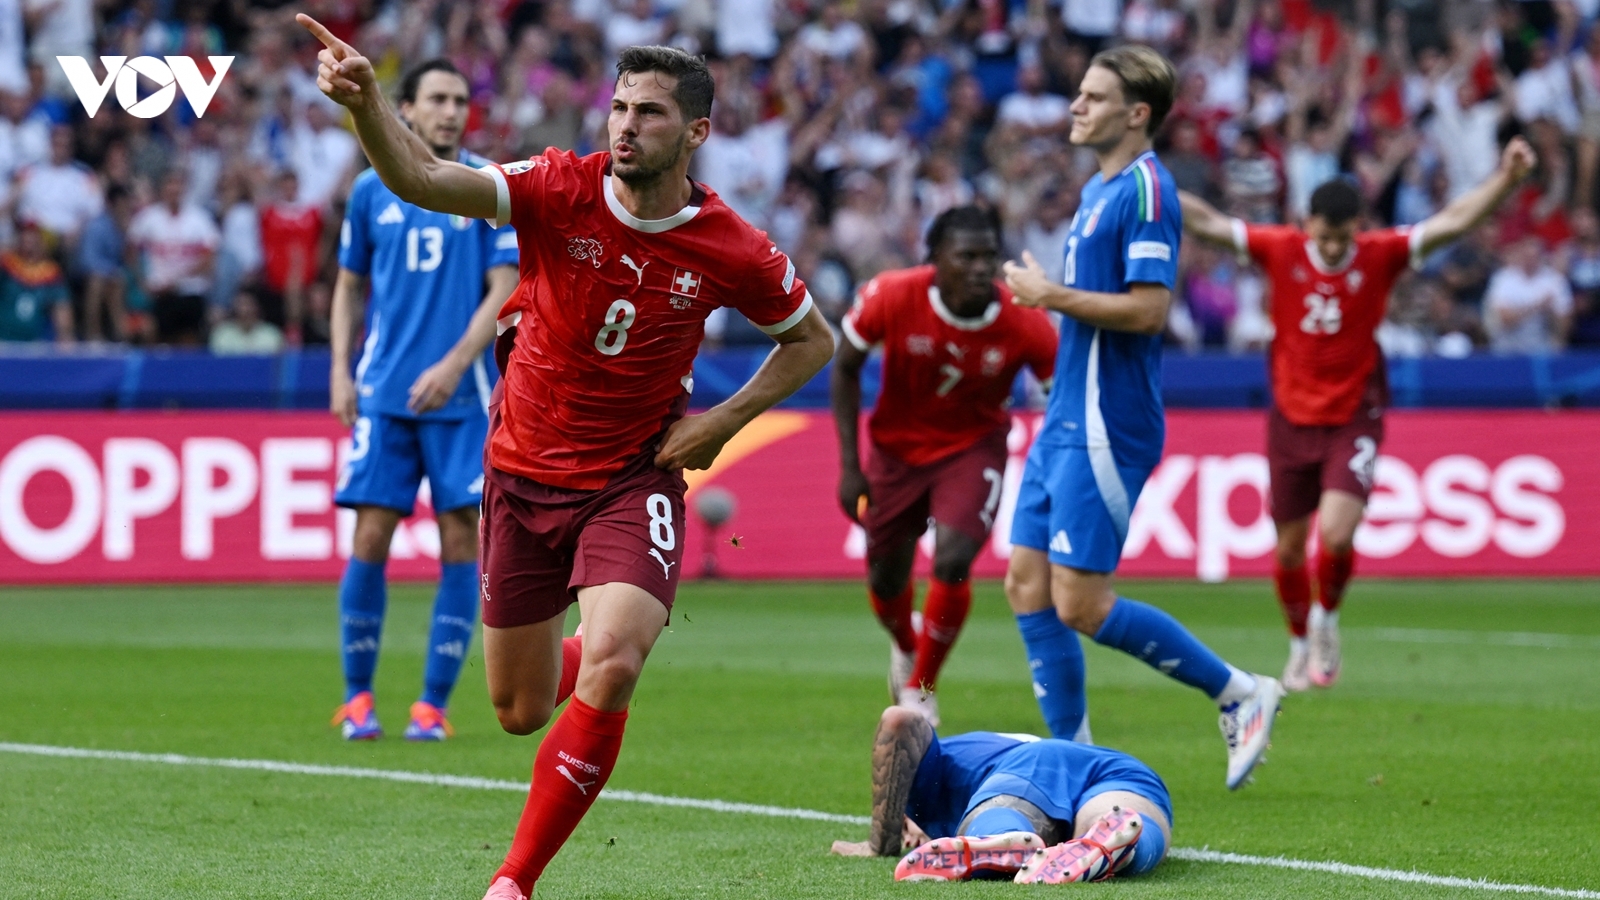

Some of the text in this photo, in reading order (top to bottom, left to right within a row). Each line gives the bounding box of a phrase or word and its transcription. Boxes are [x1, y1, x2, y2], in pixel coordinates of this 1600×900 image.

[406, 226, 444, 272] 13
[594, 299, 636, 356] 8
[1299, 292, 1342, 335] 26
[936, 364, 963, 397] 7
[646, 493, 676, 551] 8
[557, 750, 600, 776] SUISSE
